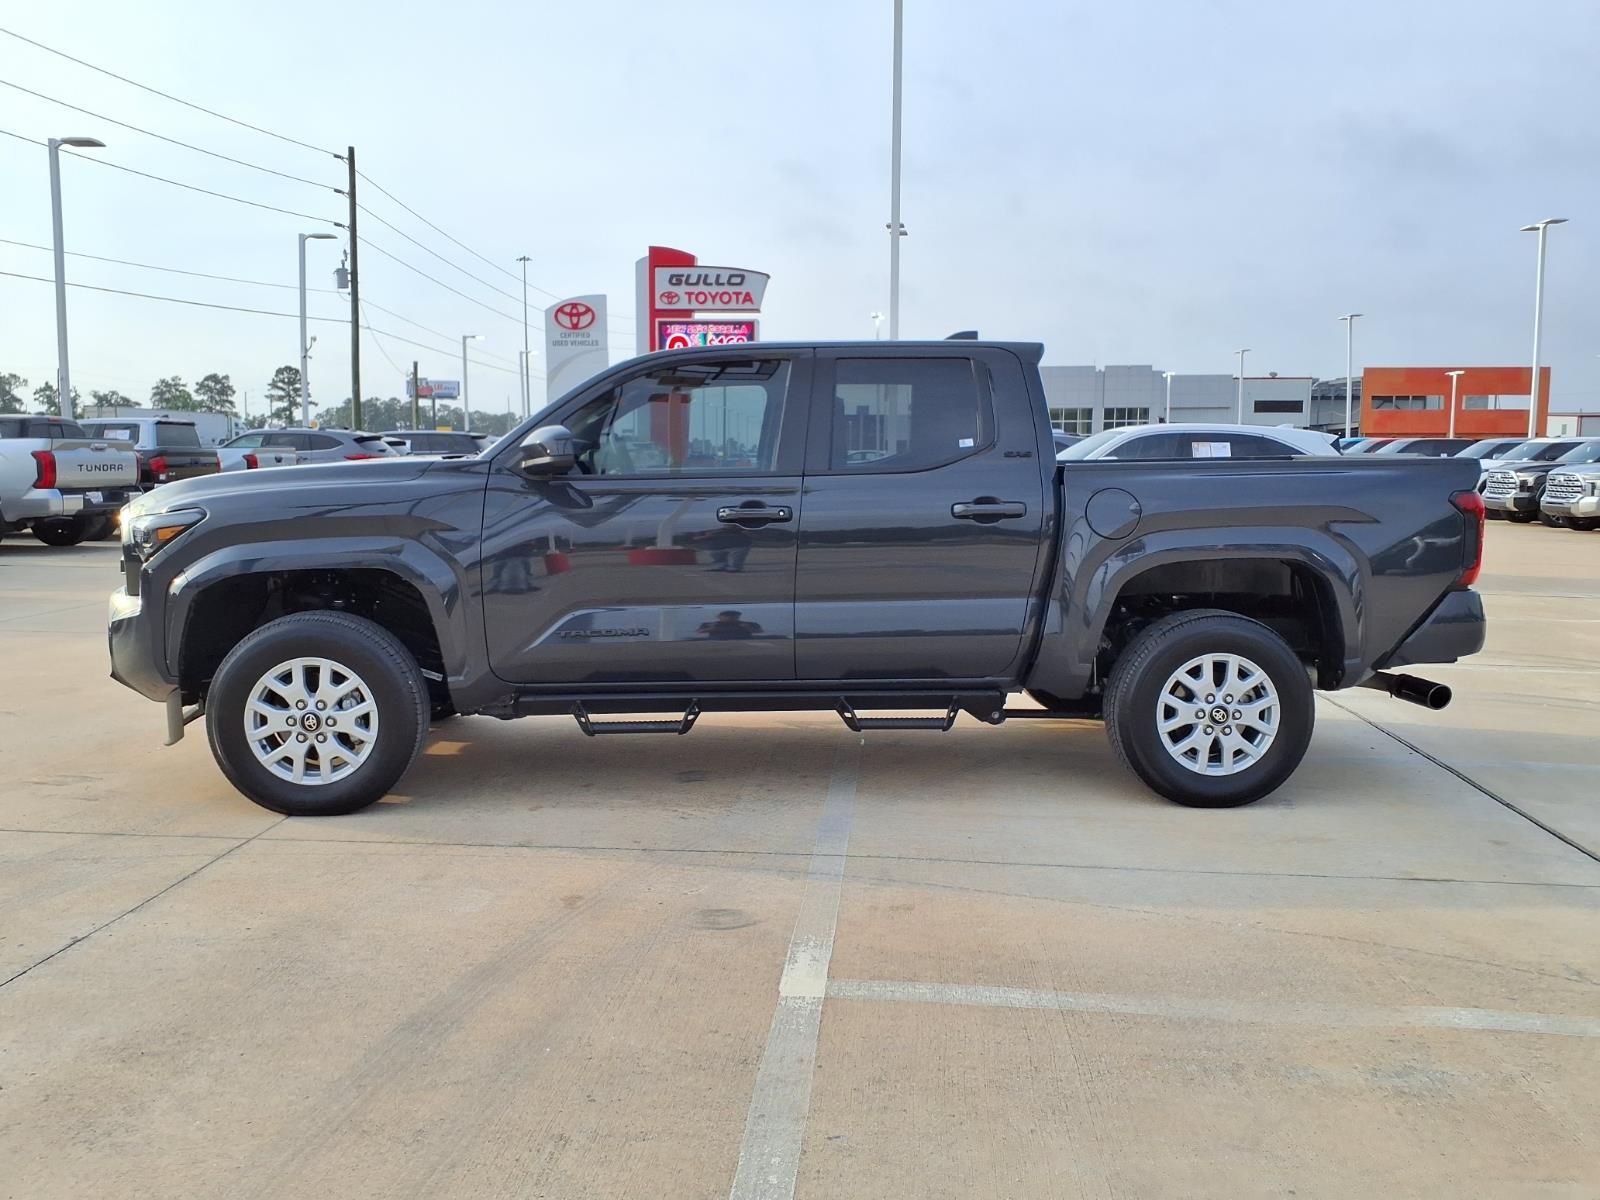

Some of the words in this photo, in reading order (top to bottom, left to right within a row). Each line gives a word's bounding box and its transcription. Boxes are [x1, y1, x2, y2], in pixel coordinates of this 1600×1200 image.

[668, 273, 746, 286] GULLO
[684, 291, 754, 305] TOYOTA
[559, 331, 591, 339] CERTIFIED
[77, 463, 124, 472] TUNDRA
[556, 628, 650, 639] TACOMA
